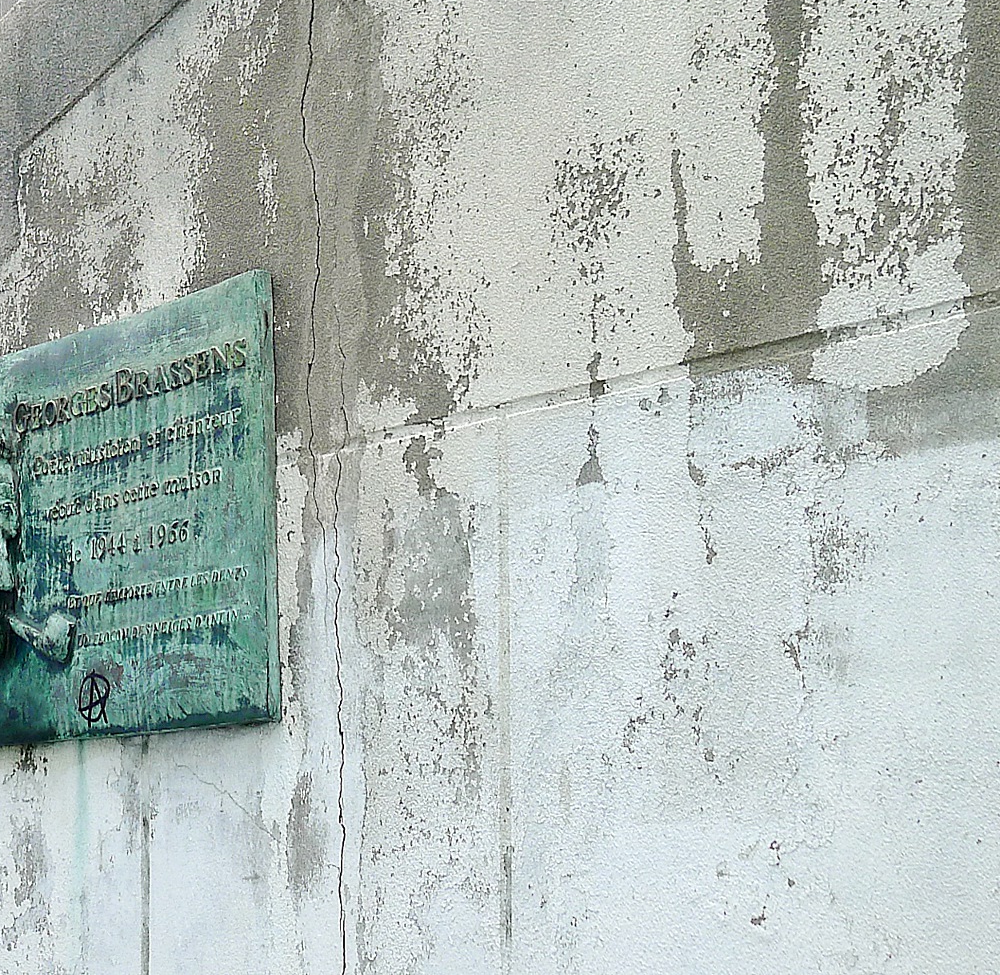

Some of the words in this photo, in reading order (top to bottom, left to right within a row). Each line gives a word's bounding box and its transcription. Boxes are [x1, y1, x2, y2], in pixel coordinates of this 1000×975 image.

[13, 381, 112, 434] GEORGES
[115, 337, 247, 405] BRASSENS
[75, 436, 141, 466] musicien
[166, 408, 241, 441] chanteur
[85, 489, 119, 513] dans
[123, 481, 160, 505] cette
[164, 468, 222, 496] maison
[66, 539, 82, 564] de
[91, 533, 126, 561] 1944
[154, 576, 188, 595] ENTRE
[190, 571, 208, 588] LES
[211, 565, 249, 584] DENTS
